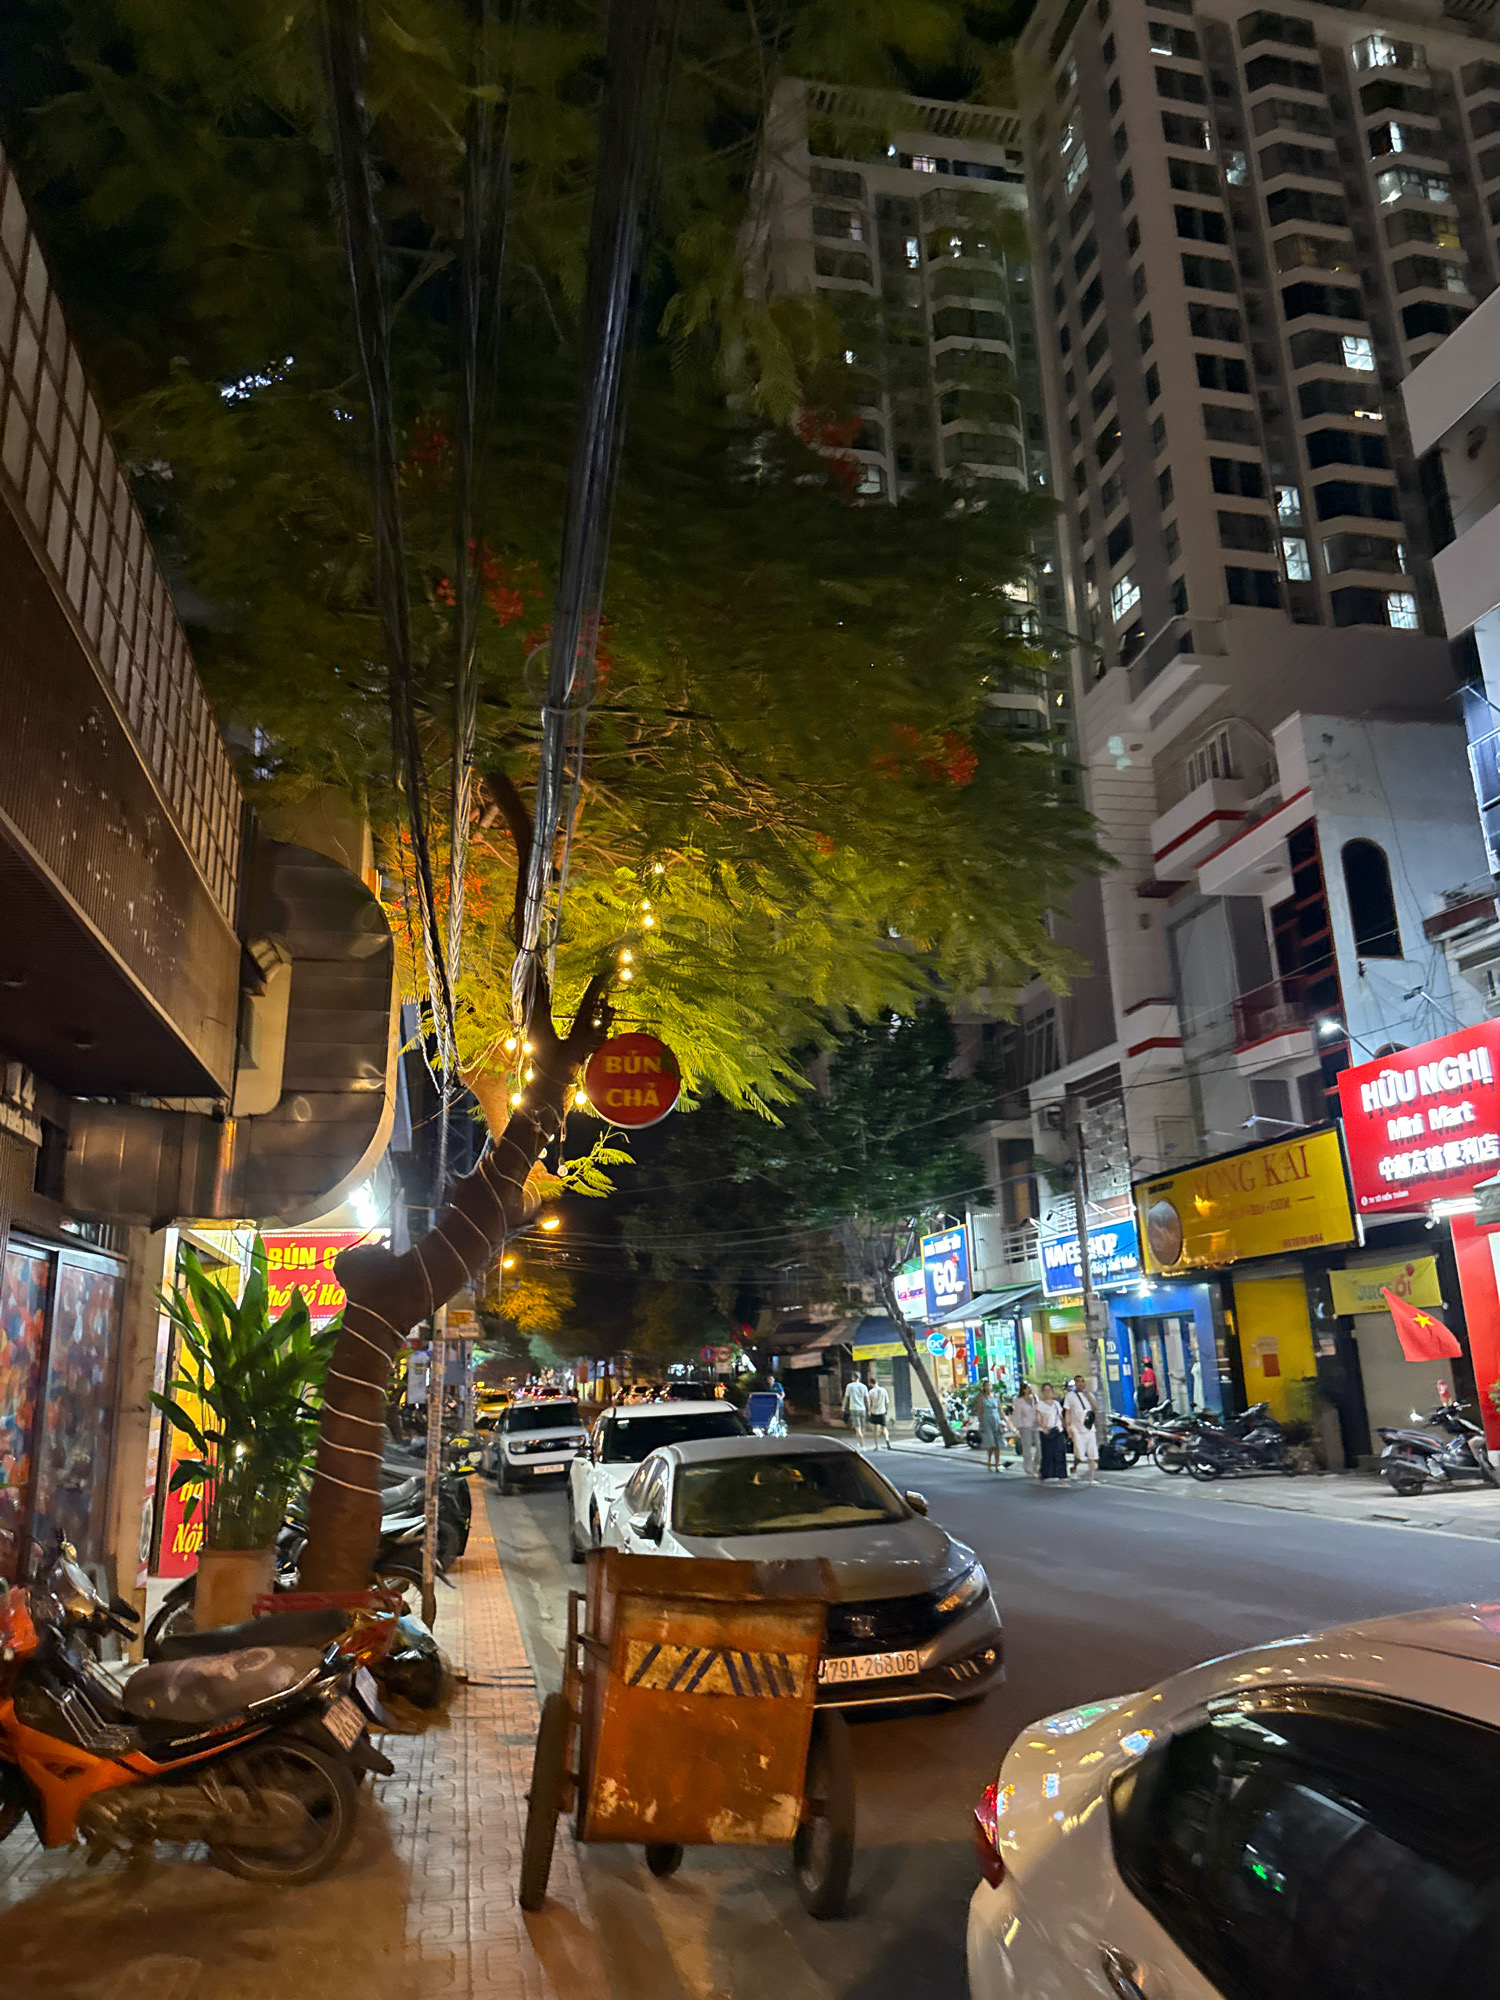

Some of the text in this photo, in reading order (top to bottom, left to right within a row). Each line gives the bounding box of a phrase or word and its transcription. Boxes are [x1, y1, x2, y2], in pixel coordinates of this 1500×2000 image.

[605, 1050, 661, 1074] BÚN
[1361, 1047, 1494, 1112] HỮU NGHỊ
[605, 1082, 660, 1107] CHẢ
[1387, 1101, 1475, 1141] Mini Mart
[1264, 1145, 1311, 1187] KAI
[268, 1243, 316, 1270] BÚN
[172, 1522, 204, 1561] Nội
